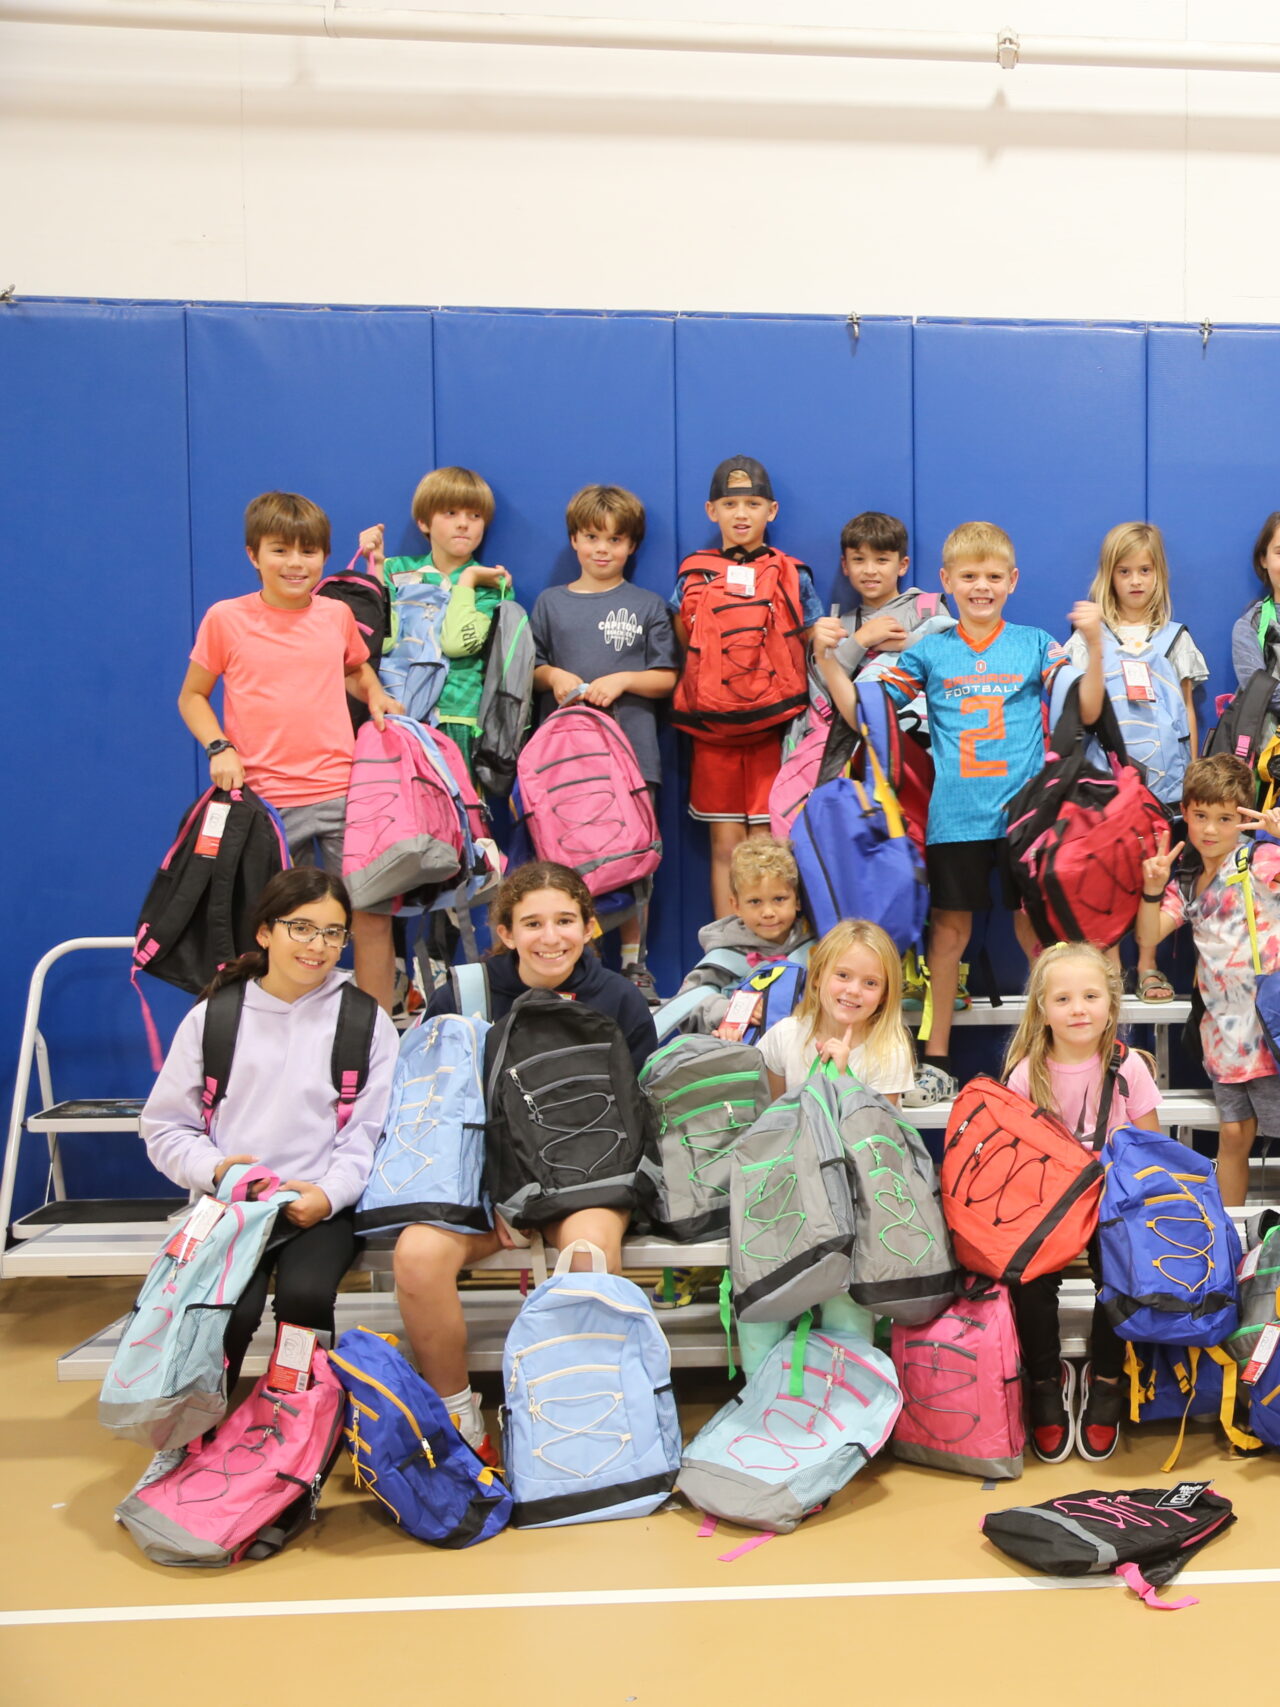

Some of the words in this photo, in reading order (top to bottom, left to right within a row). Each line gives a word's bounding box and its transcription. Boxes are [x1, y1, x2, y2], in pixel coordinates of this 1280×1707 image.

[598, 620, 643, 636] CAPITOLA
[943, 673, 1024, 689] GRIDIRON
[945, 684, 1021, 700] FOOTBALL
[959, 695, 1008, 778] 2
